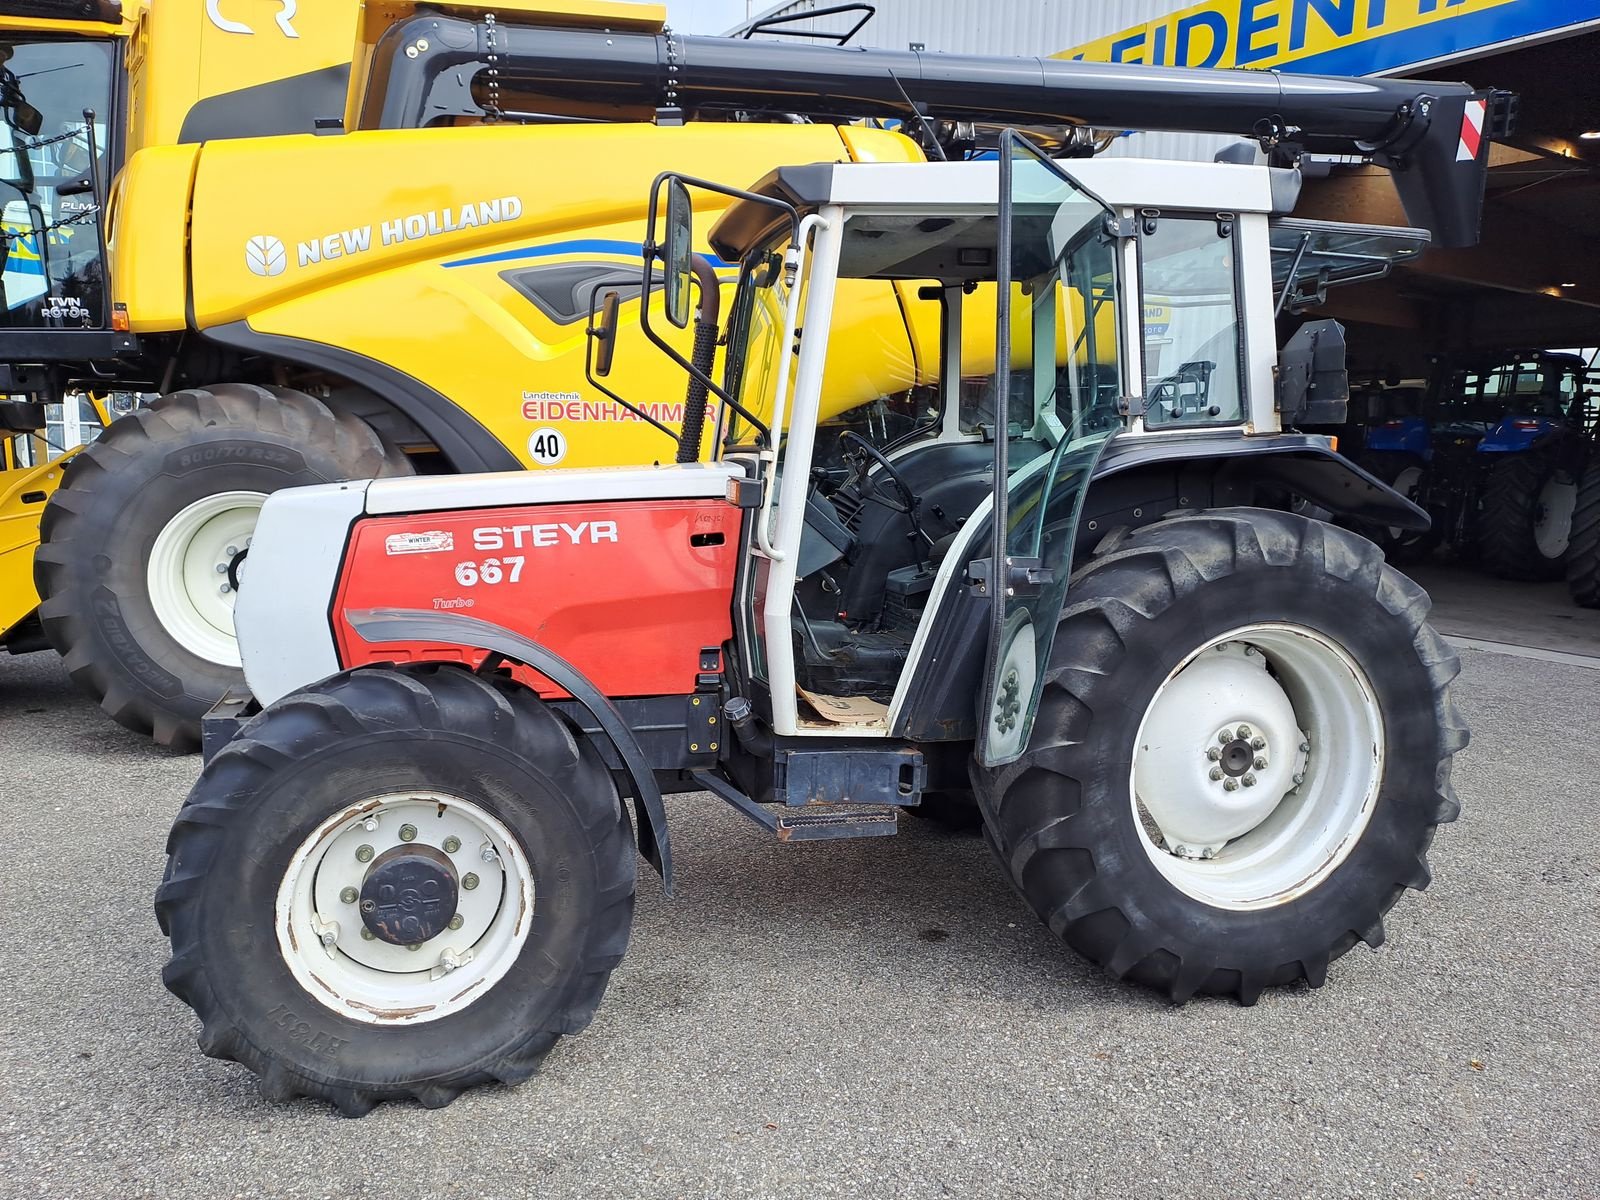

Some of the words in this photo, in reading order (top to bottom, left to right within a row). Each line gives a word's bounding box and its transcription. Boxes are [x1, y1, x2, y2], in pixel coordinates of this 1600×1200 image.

[297, 225, 372, 267] NEW
[381, 196, 522, 246] HOLLAND
[48, 297, 81, 307] TWIN
[41, 306, 91, 318] ROTOR
[523, 391, 580, 400] Landtechnik
[522, 401, 716, 422] EIDENHAMMR
[534, 434, 559, 458] 40
[407, 536, 431, 544] WINTER
[473, 520, 618, 550] STEYR
[454, 556, 526, 587] 667
[432, 597, 475, 609] Turbo
